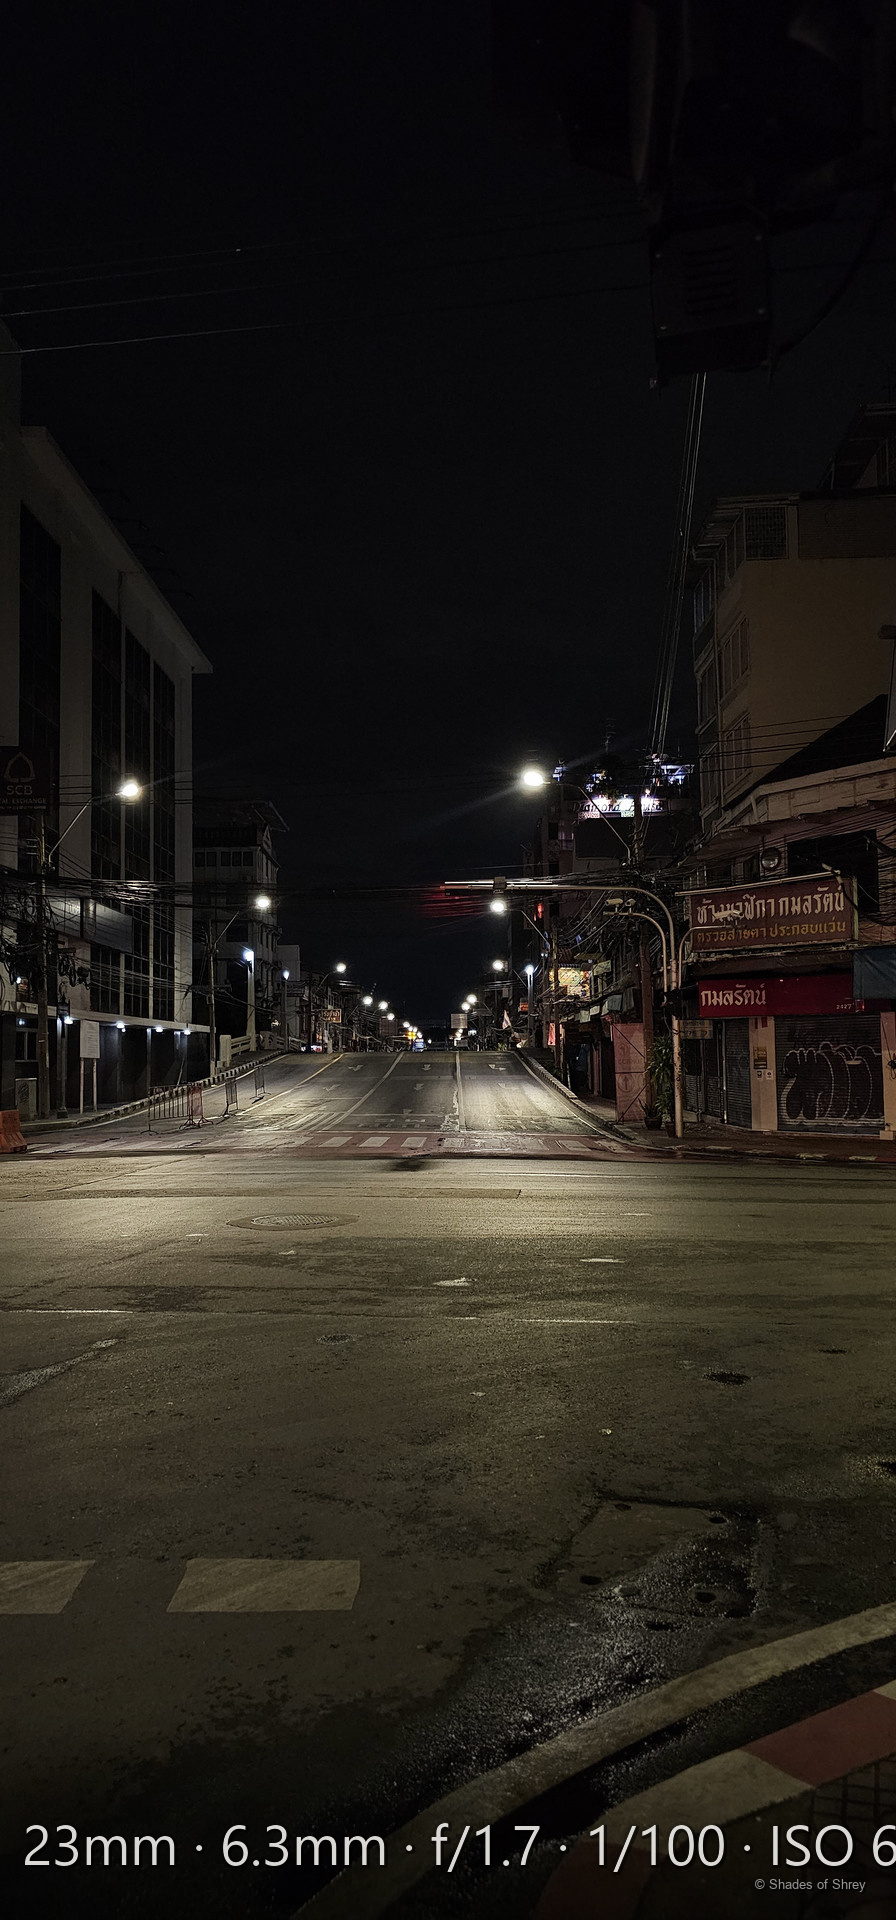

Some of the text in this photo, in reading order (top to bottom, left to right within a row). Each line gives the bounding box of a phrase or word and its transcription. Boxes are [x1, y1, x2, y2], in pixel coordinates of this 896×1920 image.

[6, 785, 33, 795] SCB
[769, 917, 847, 938] ประกอบแว่น
[700, 983, 768, 1007] กมลรัตน์
